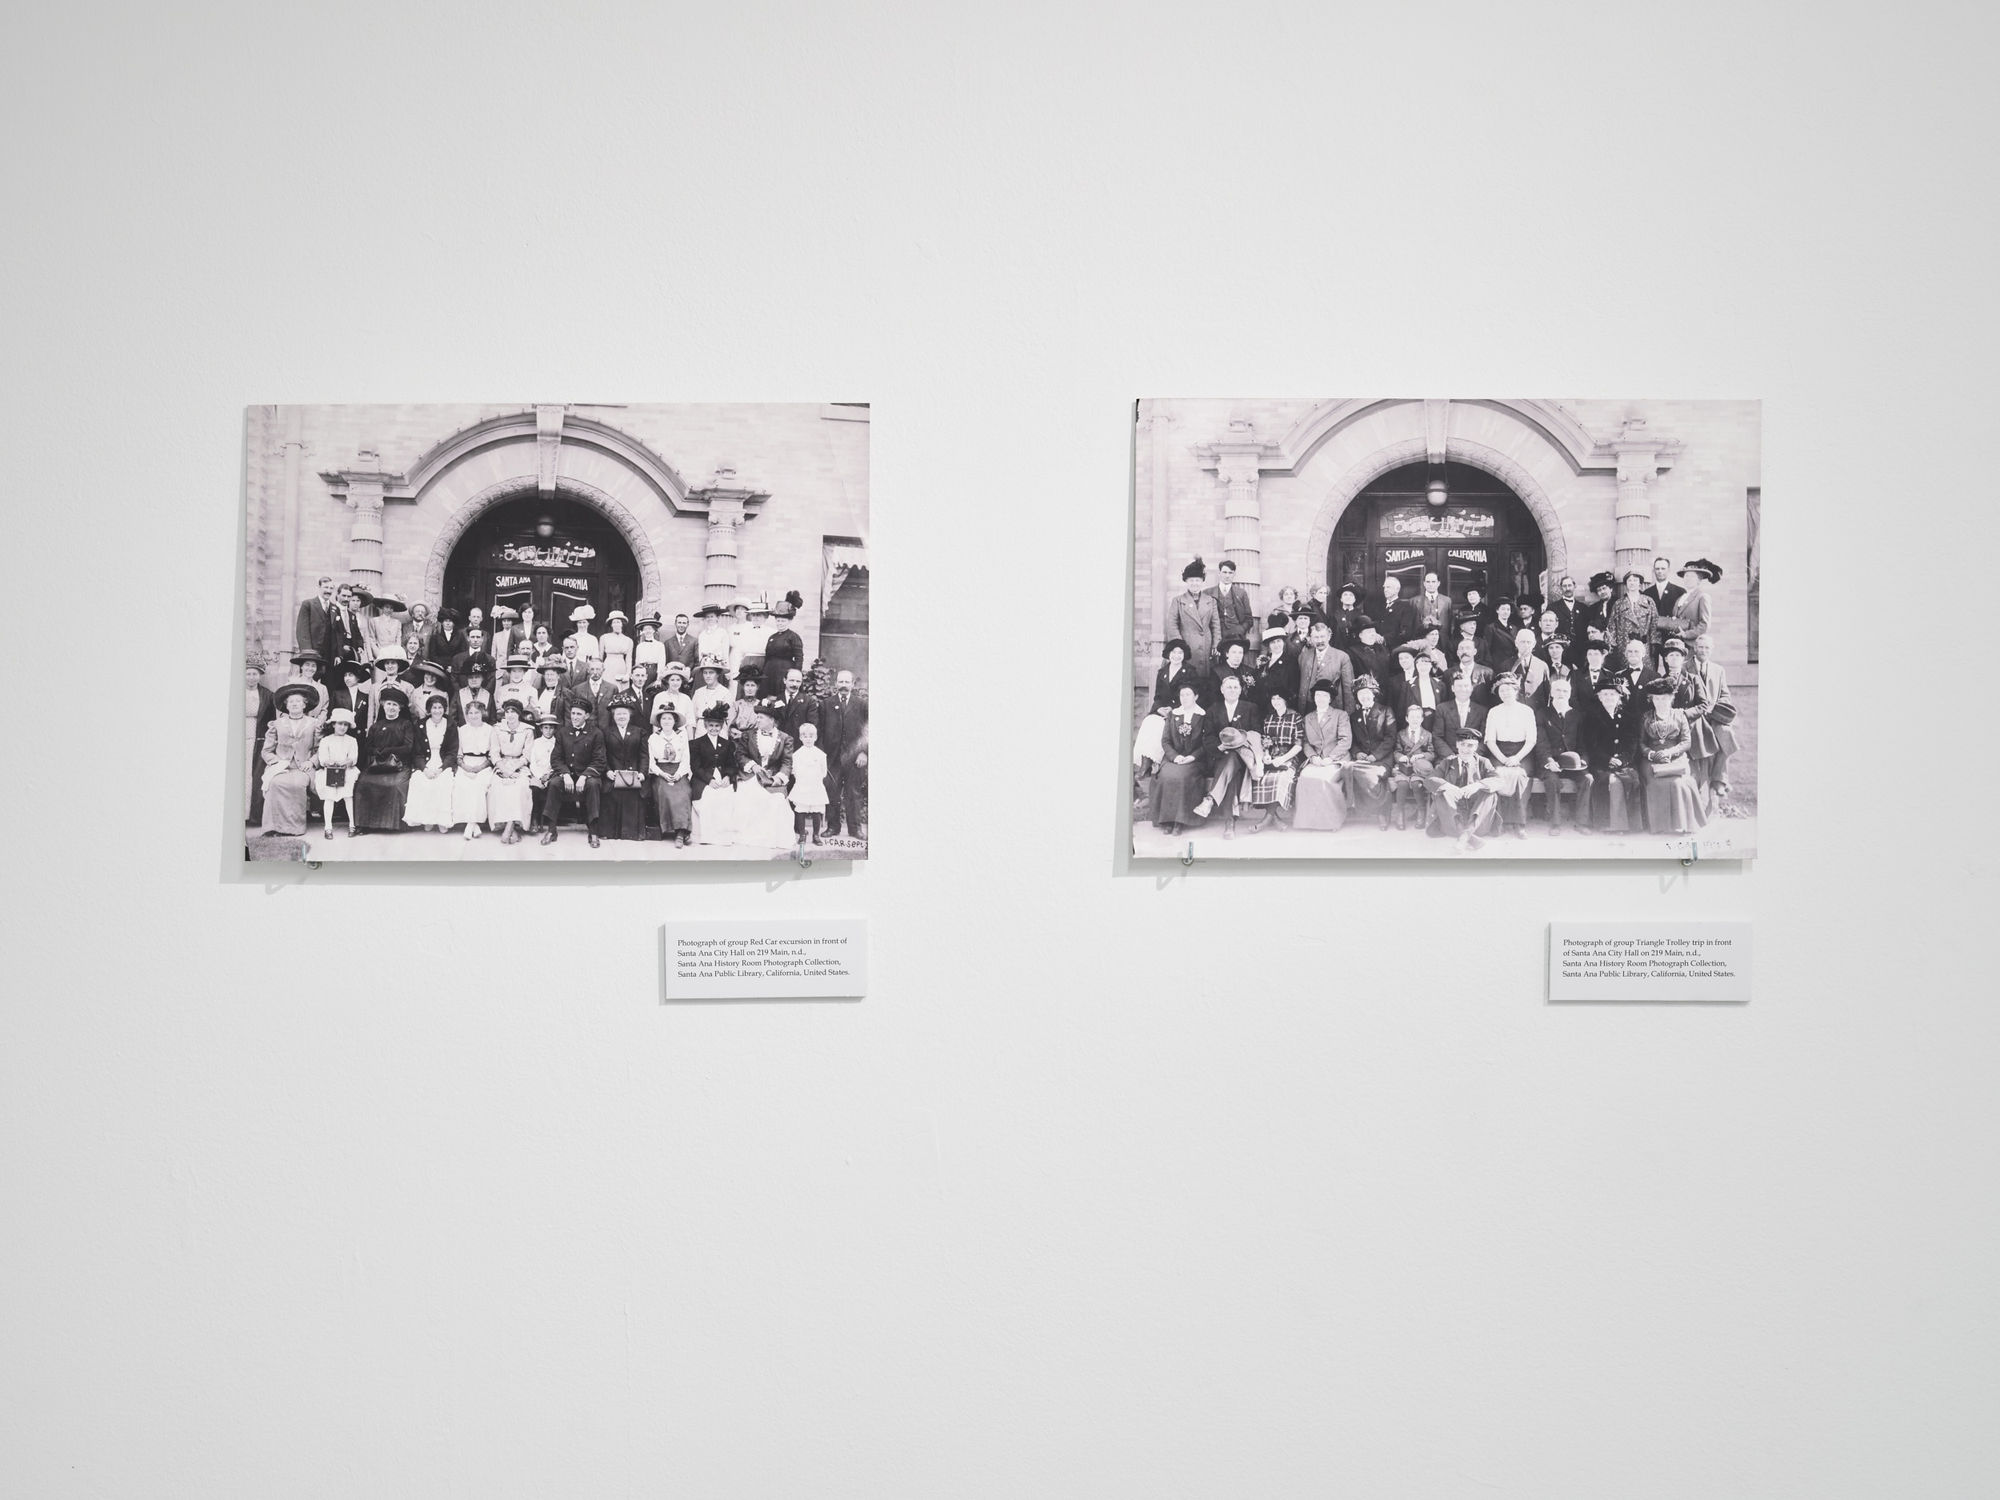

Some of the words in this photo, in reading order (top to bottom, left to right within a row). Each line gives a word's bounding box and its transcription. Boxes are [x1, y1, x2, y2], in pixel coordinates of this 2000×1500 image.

[1385, 550, 1409, 562] SANTA
[1448, 550, 1487, 562] CALIFORNIA
[496, 576, 518, 587] SANTA
[553, 578, 588, 591] CALIFORNIA
[678, 939, 717, 947] Photograph
[1563, 939, 1603, 947] Photograph
[1636, 939, 1664, 947] Triangle
[1666, 939, 1690, 947] Trolley
[1692, 939, 1705, 947] trip
[714, 950, 728, 958] City
[791, 948, 806, 956] n.d.,
[1608, 950, 1622, 958] City
[714, 960, 740, 968] History
[763, 959, 803, 967] Photograph
[1599, 960, 1625, 968] History
[1649, 960, 1689, 968] Photograph
[737, 970, 765, 978] Library,
